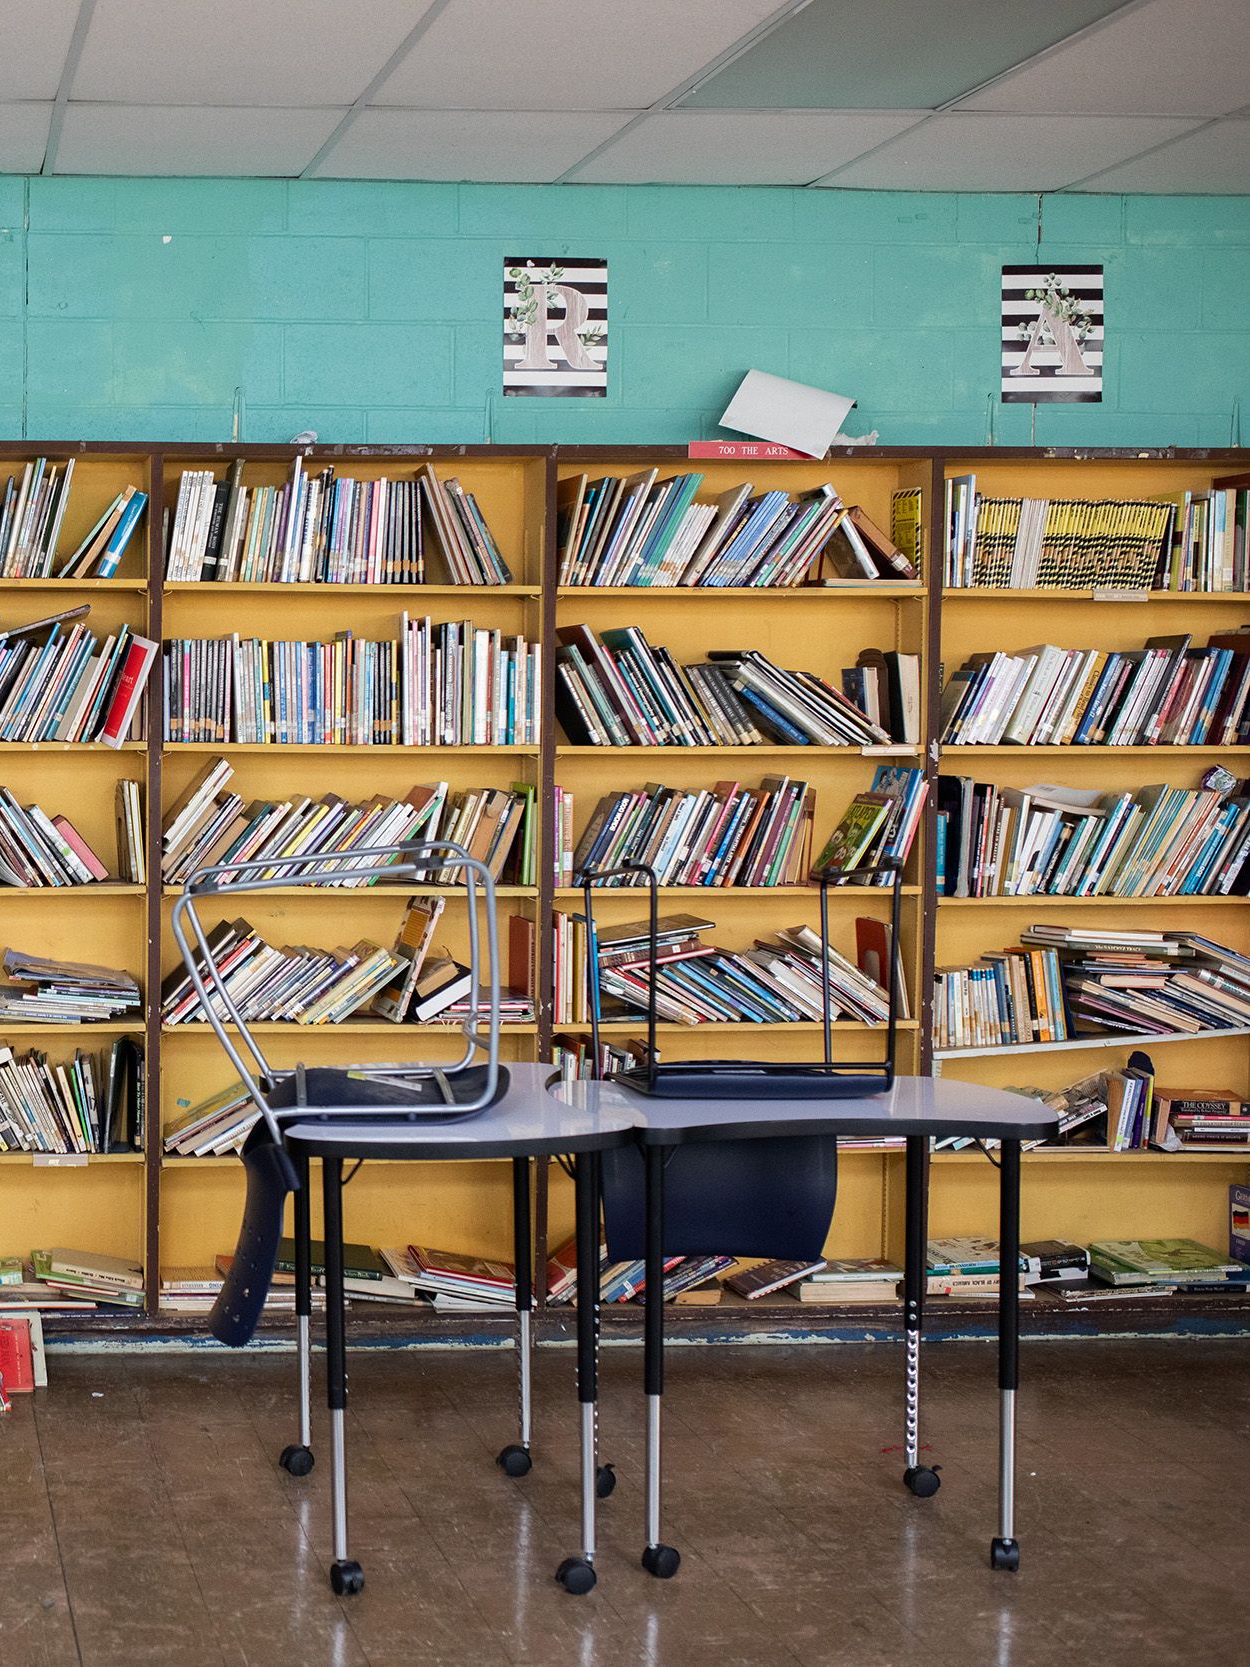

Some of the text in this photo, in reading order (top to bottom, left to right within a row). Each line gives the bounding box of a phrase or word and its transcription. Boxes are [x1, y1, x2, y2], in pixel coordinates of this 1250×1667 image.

[514, 285, 603, 370] R
[1010, 290, 1094, 376] A
[719, 446, 788, 455] 700 THE ARTS
[1197, 1102, 1226, 1110] ODYSSEY
